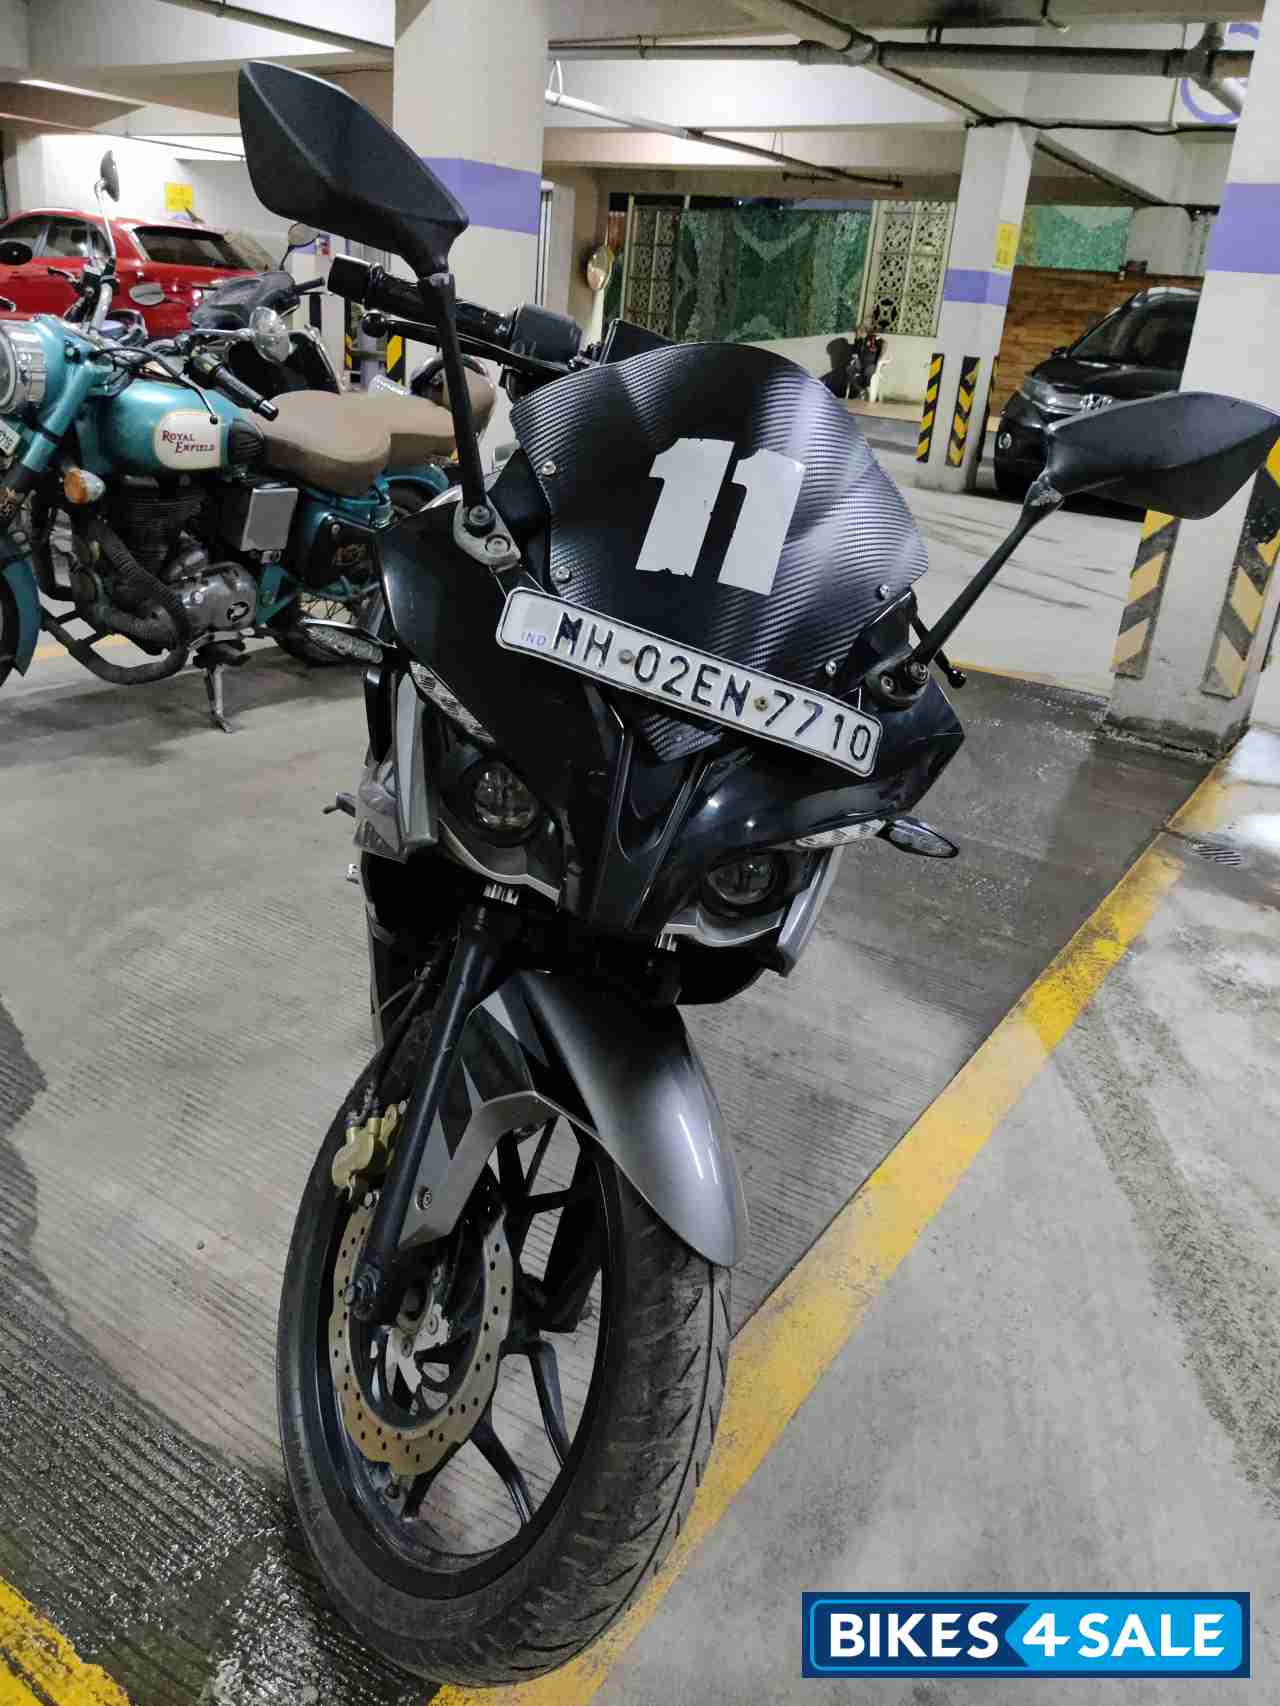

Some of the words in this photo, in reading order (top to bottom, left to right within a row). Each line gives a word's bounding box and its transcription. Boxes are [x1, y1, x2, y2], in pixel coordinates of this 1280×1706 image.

[161, 430, 194, 443] ROYAL
[635, 437, 807, 596] 11
[553, 611, 614, 666] MH
[633, 644, 751, 717] 02EN
[764, 689, 872, 761] 7710
